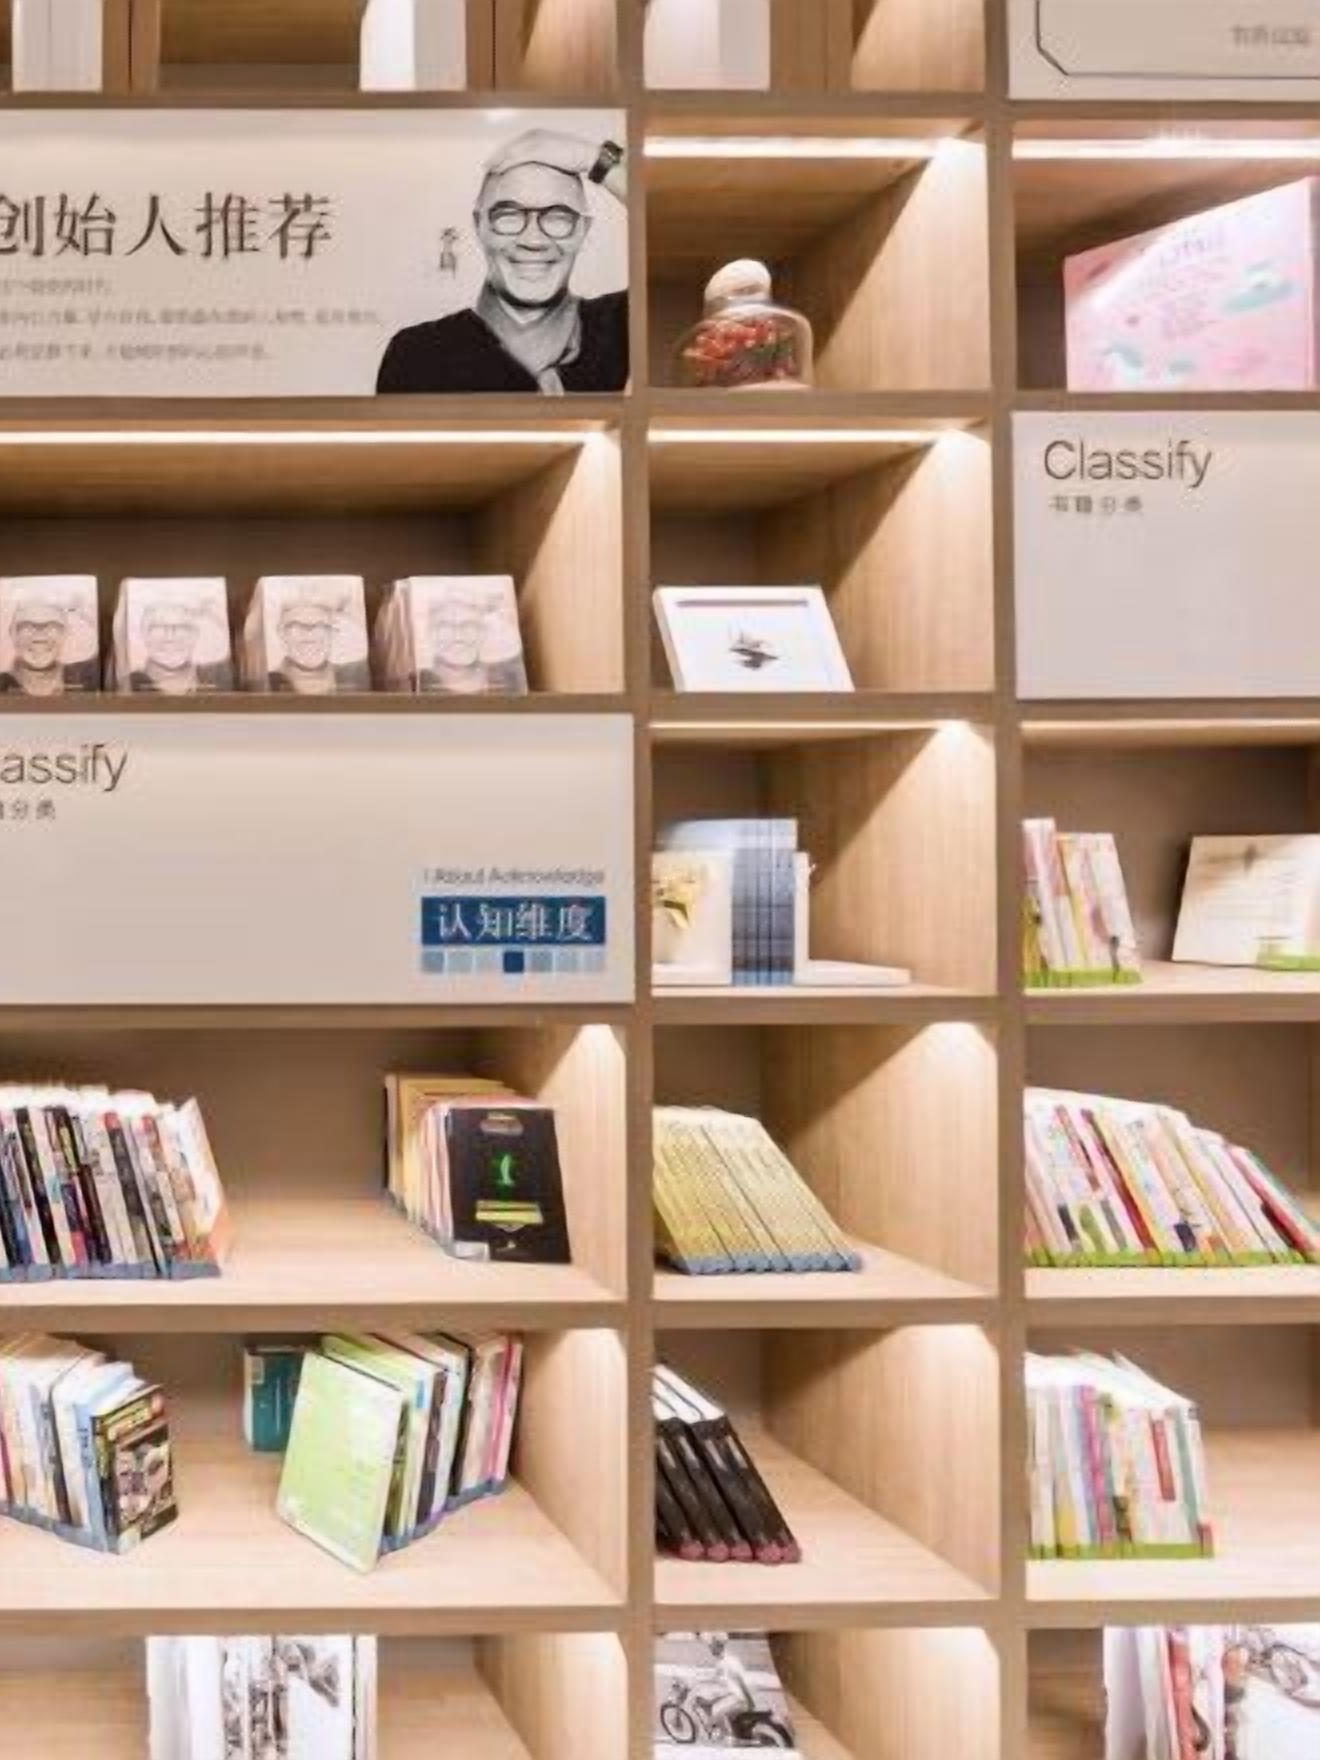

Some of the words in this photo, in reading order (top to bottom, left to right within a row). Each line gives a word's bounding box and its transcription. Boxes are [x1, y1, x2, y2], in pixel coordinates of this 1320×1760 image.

[1044, 438, 1213, 489] Classify
[437, 902, 597, 942] 认知维度
